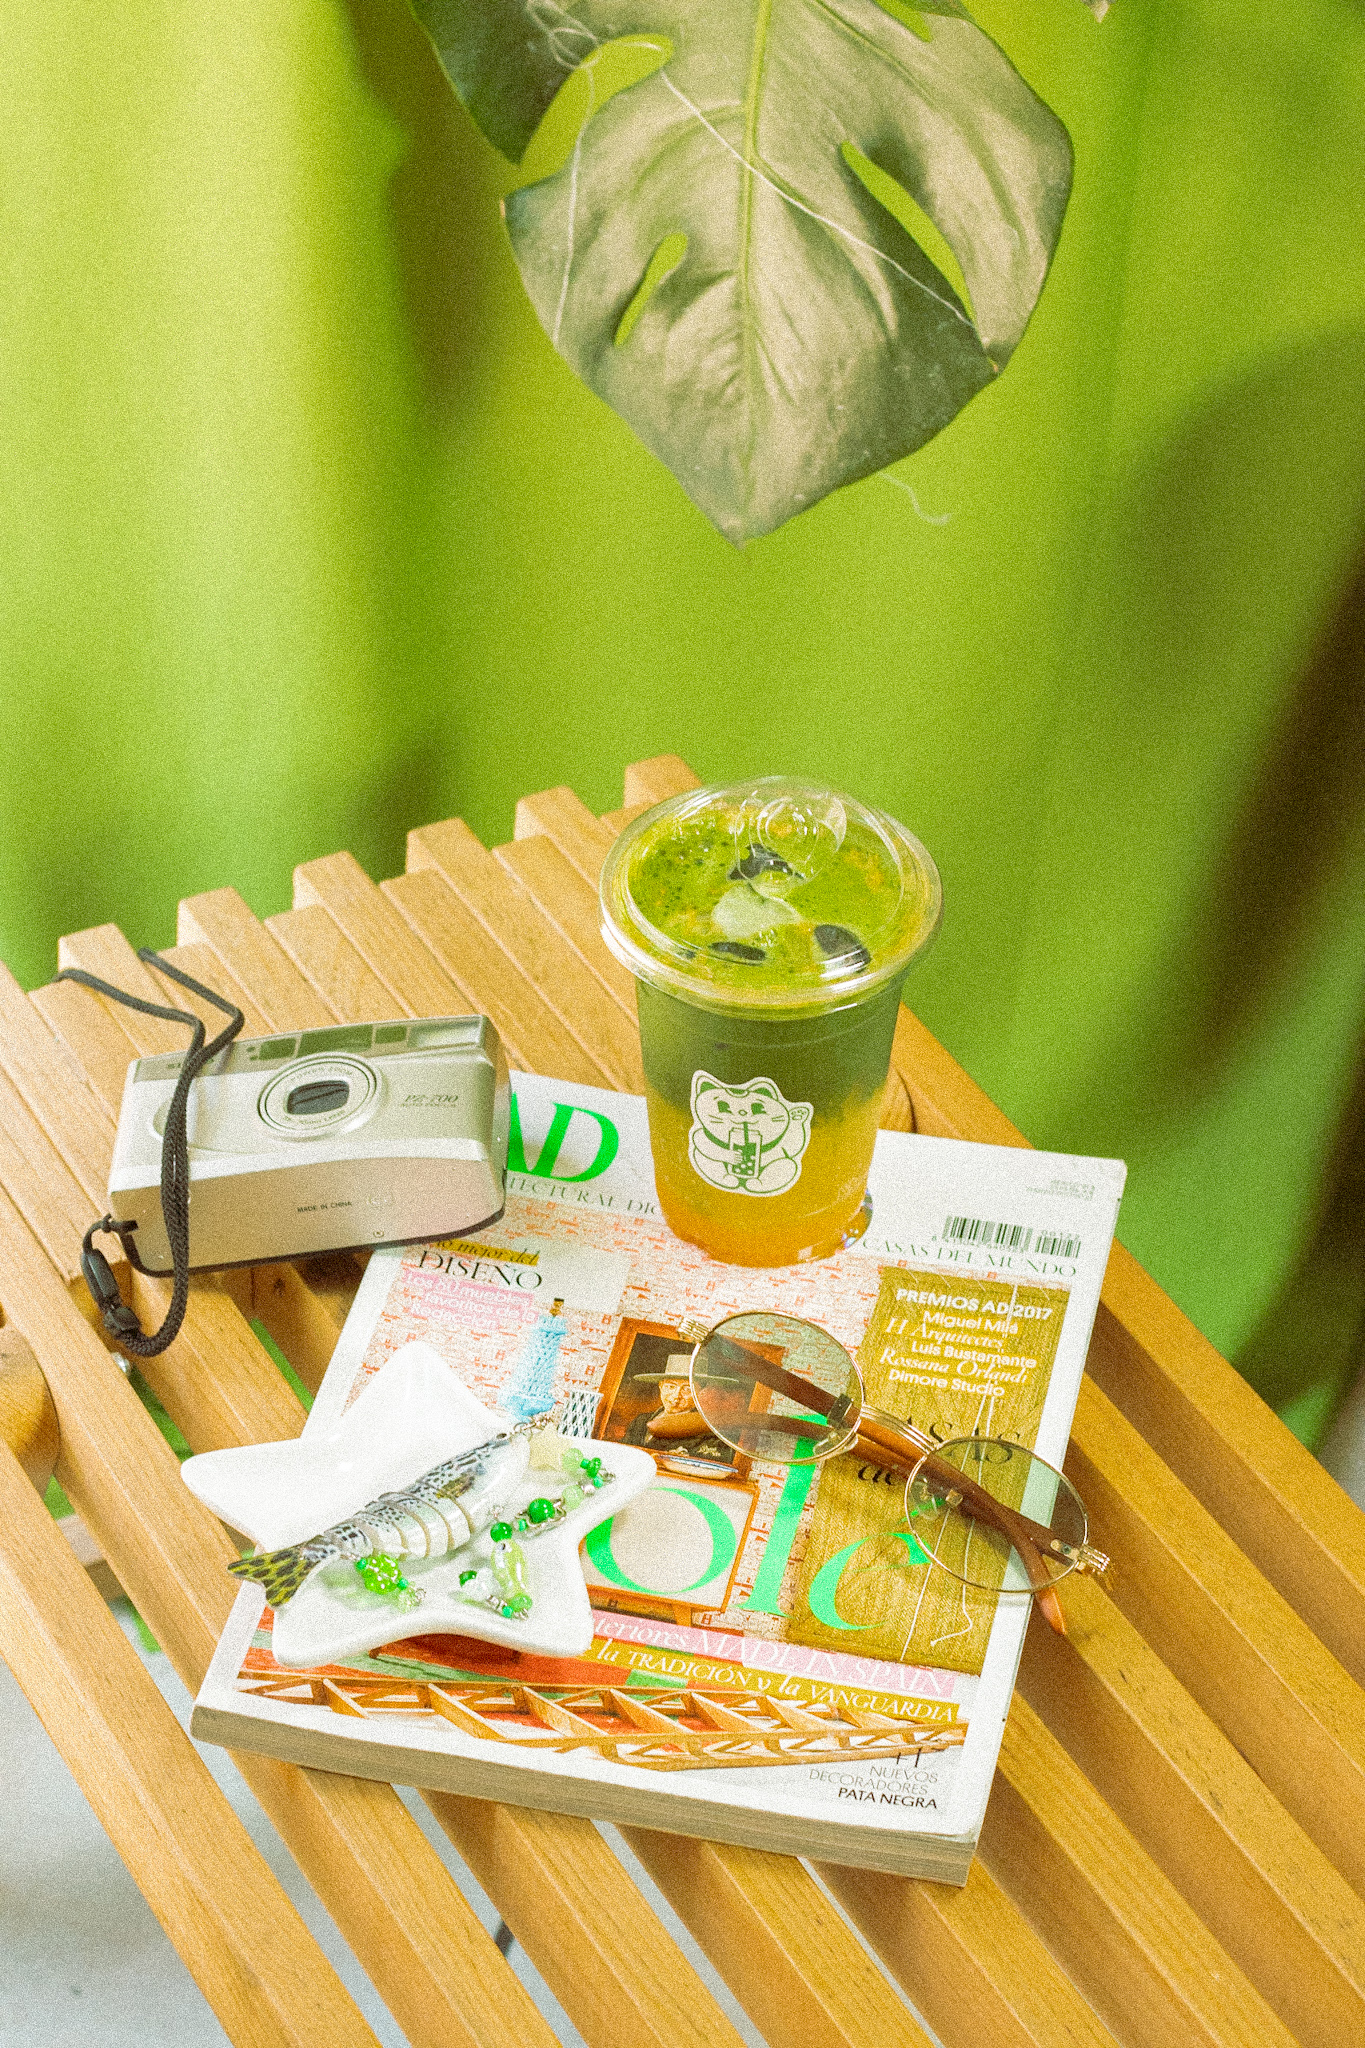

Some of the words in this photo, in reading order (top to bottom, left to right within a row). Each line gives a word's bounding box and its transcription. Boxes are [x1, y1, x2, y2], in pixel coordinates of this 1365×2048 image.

[297, 1204, 317, 1213] MADE
[330, 1200, 353, 1210] CHINA
[458, 1242, 503, 1260] mejor
[509, 1247, 541, 1265] del
[862, 1238, 929, 1257] CASAS
[937, 1246, 977, 1264] DEL
[984, 1252, 1077, 1278] MUNDO
[418, 1249, 543, 1290] DISEÑO
[406, 1271, 434, 1288] Los
[460, 1285, 530, 1306] muebles
[425, 1292, 494, 1315] favoritos
[496, 1304, 520, 1319] de
[522, 1308, 537, 1322] la
[895, 1288, 980, 1312] PREMIOS
[981, 1301, 1009, 1316] AD
[1012, 1305, 1053, 1321] 2017
[922, 1310, 981, 1330] Miguel
[879, 1347, 950, 1374] Rossana
[956, 1360, 1029, 1384] Orlandi
[910, 1340, 942, 1357] Luis
[943, 1345, 1038, 1369] Bustamante
[888, 1368, 949, 1389] Dimore
[950, 1378, 1006, 1397] Studio
[594, 1617, 690, 1650] teriores
[690, 1628, 792, 1669] MADE
[804, 1650, 845, 1680] IN
[848, 1658, 953, 1698] SPAIN
[597, 1638, 619, 1663] la
[628, 1650, 752, 1688] TRADICIÓN
[777, 1674, 802, 1696] la
[811, 1683, 954, 1723] VANGUARDIA
[808, 1767, 929, 1796] DECORADORES
[868, 1764, 940, 1785] NUEVOS
[838, 1786, 876, 1804] PATA
[879, 1792, 938, 1809] NEGRA
